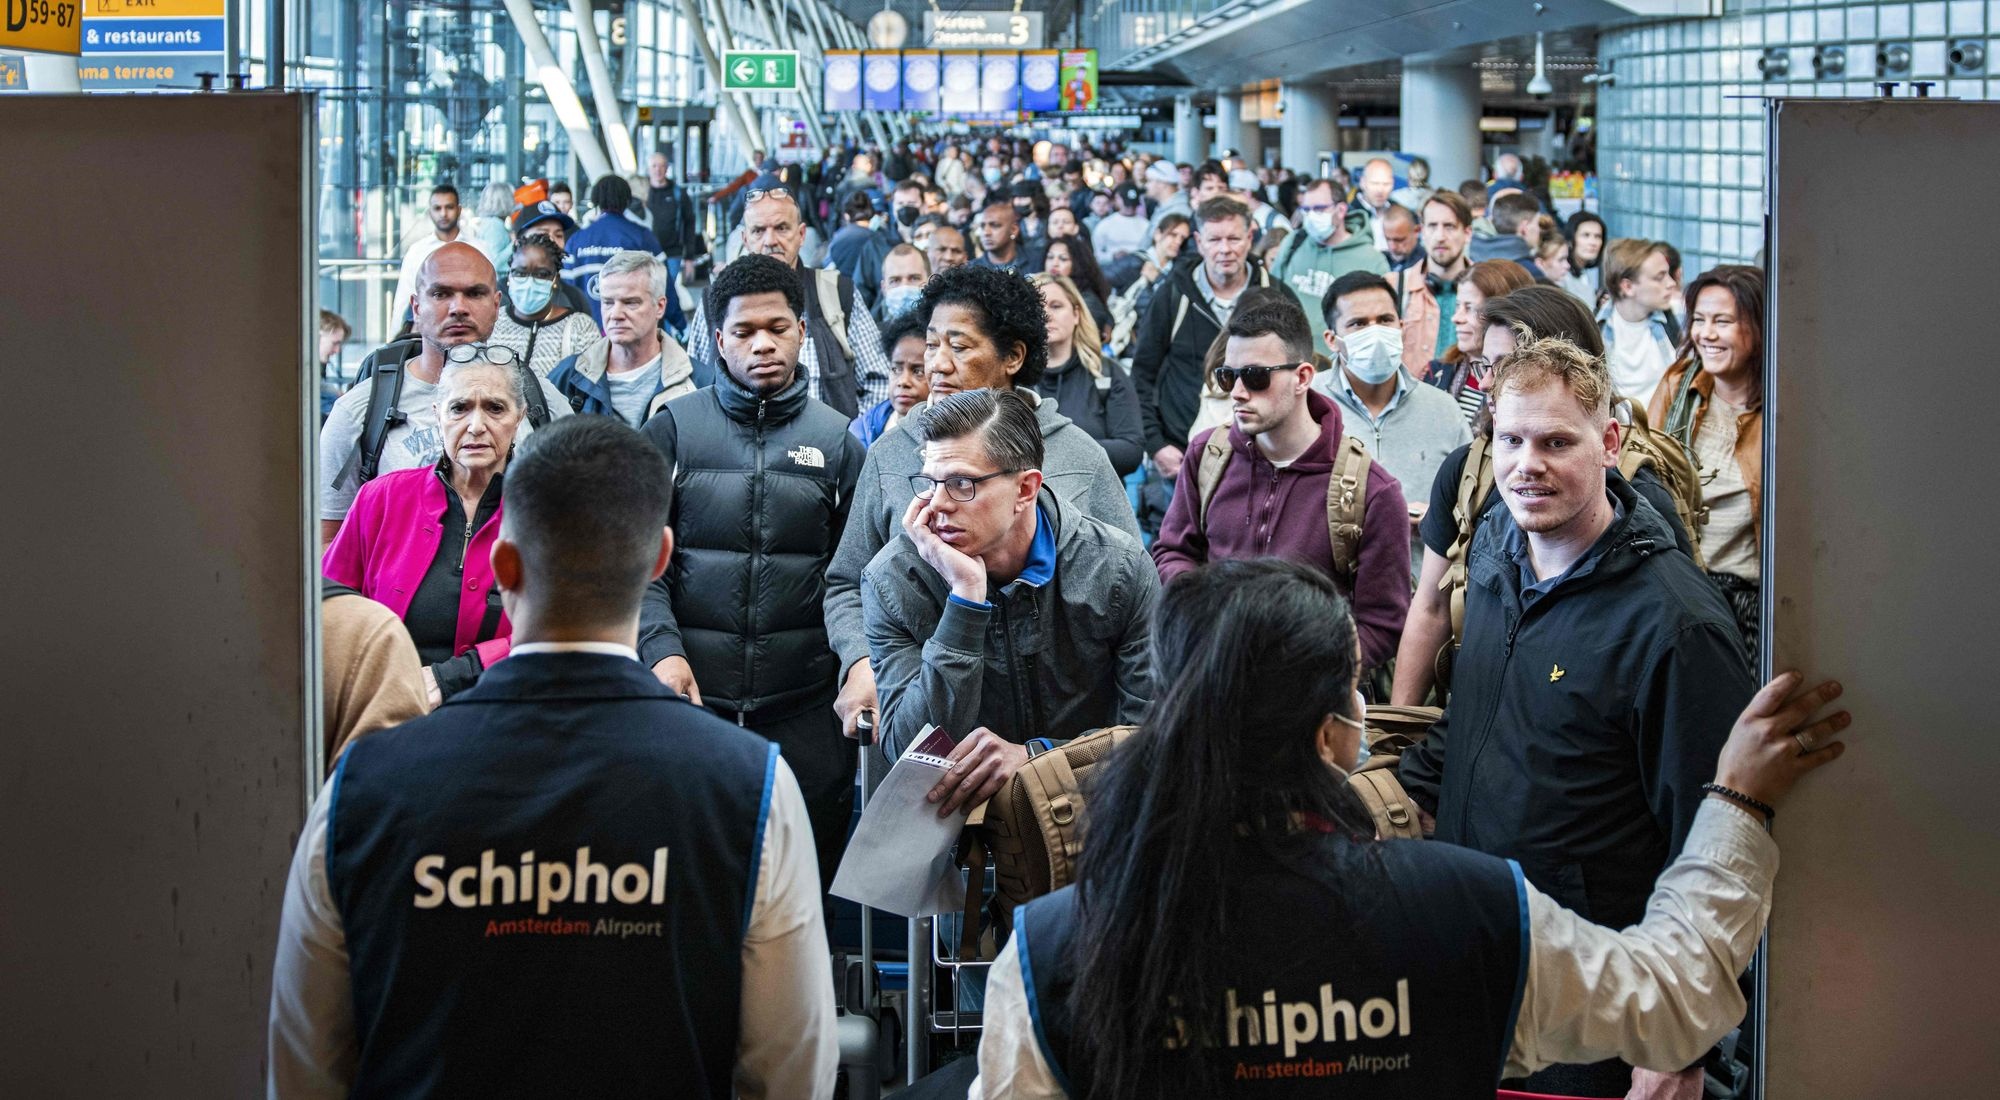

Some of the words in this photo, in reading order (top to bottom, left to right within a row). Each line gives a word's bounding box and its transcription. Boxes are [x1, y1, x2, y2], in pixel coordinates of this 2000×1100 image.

[7, 0, 27, 31] D
[30, 0, 74, 27] 59-87
[934, 15, 986, 29] Vertrek
[87, 28, 99, 44] &
[105, 28, 202, 44] restaurants
[934, 31, 1006, 45] Departures
[1008, 15, 1029, 45] 3
[114, 65, 174, 79] terrace
[788, 450, 813, 460] NORTH
[795, 457, 813, 466] FACE
[413, 846, 669, 915] Schiphol
[485, 917, 590, 937] Amsterdam
[594, 918, 662, 939] Airport
[1163, 978, 1411, 1058] hiphol
[1234, 1056, 1343, 1080] Amsterdam
[1347, 1053, 1411, 1075] Airport
